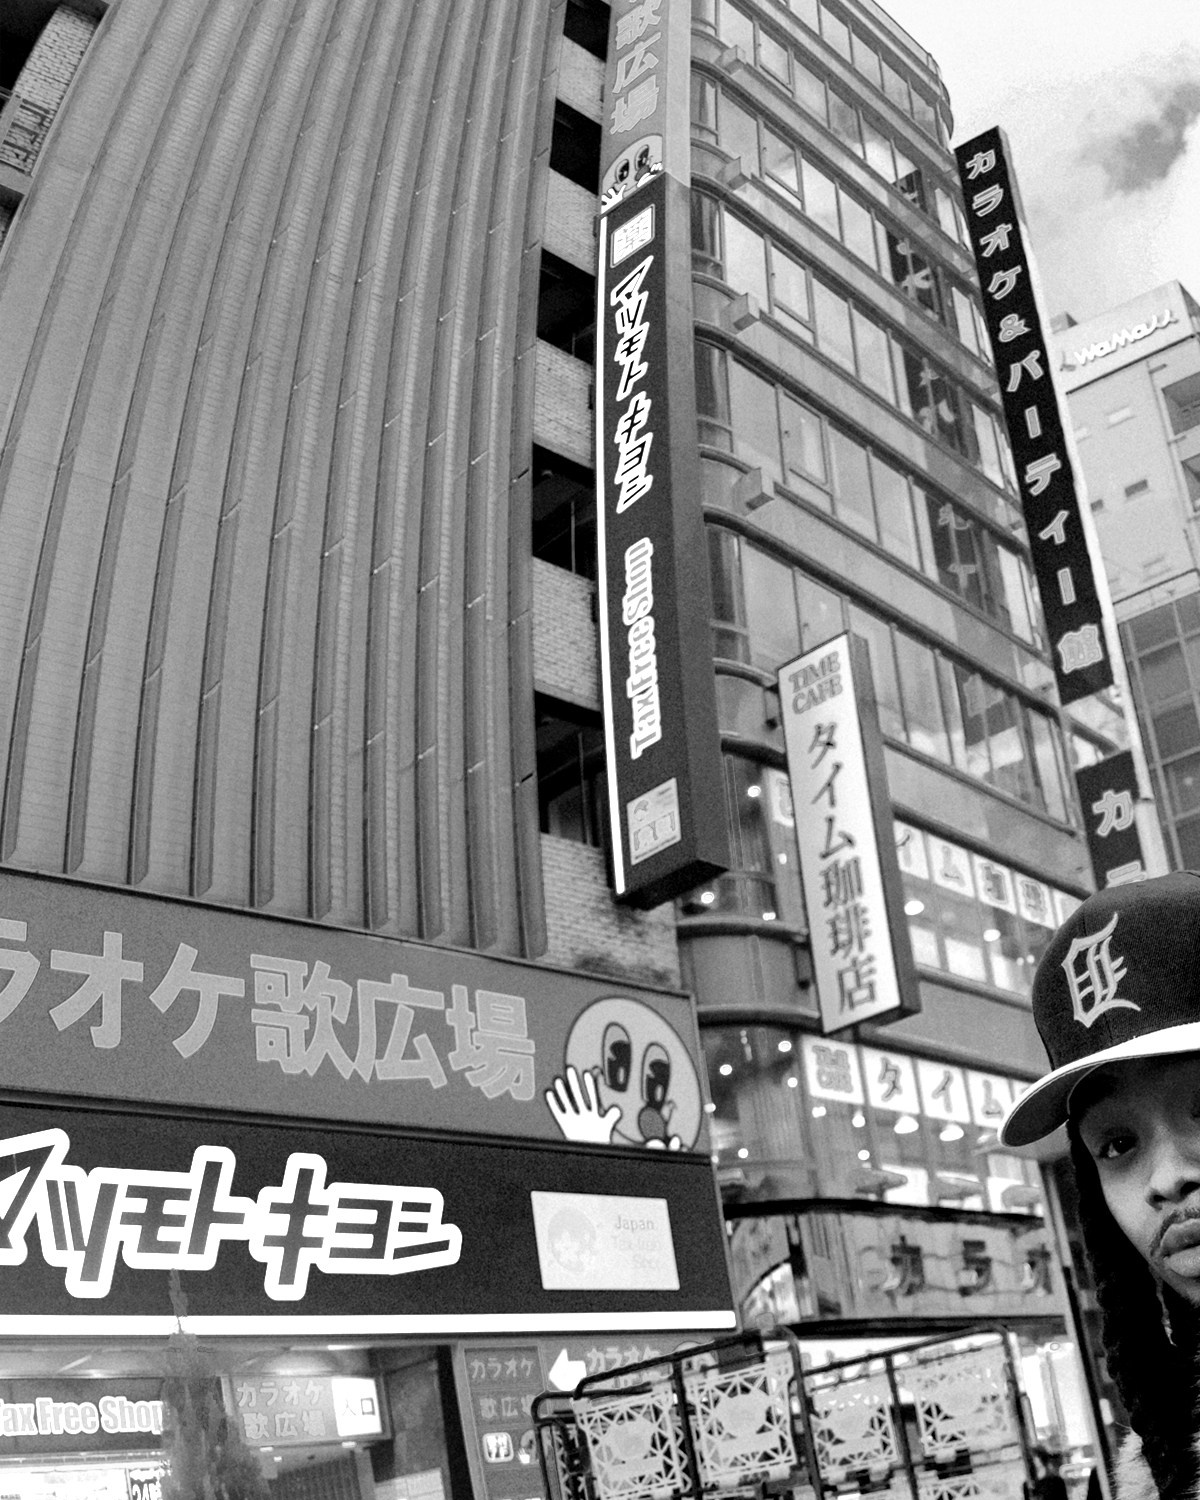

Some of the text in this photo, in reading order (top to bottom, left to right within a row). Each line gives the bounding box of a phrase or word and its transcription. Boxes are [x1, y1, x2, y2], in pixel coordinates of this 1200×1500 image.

[788, 650, 841, 694] TIME
[792, 674, 844, 715] CAFE
[808, 721, 877, 1015] タイム珈琲店
[471, 1356, 535, 1380] カラオケ
[237, 1379, 324, 1408] カラオケ
[0, 1398, 38, 1436] ax
[36, 1397, 100, 1435] Free
[243, 1410, 326, 1439] 歌広場
